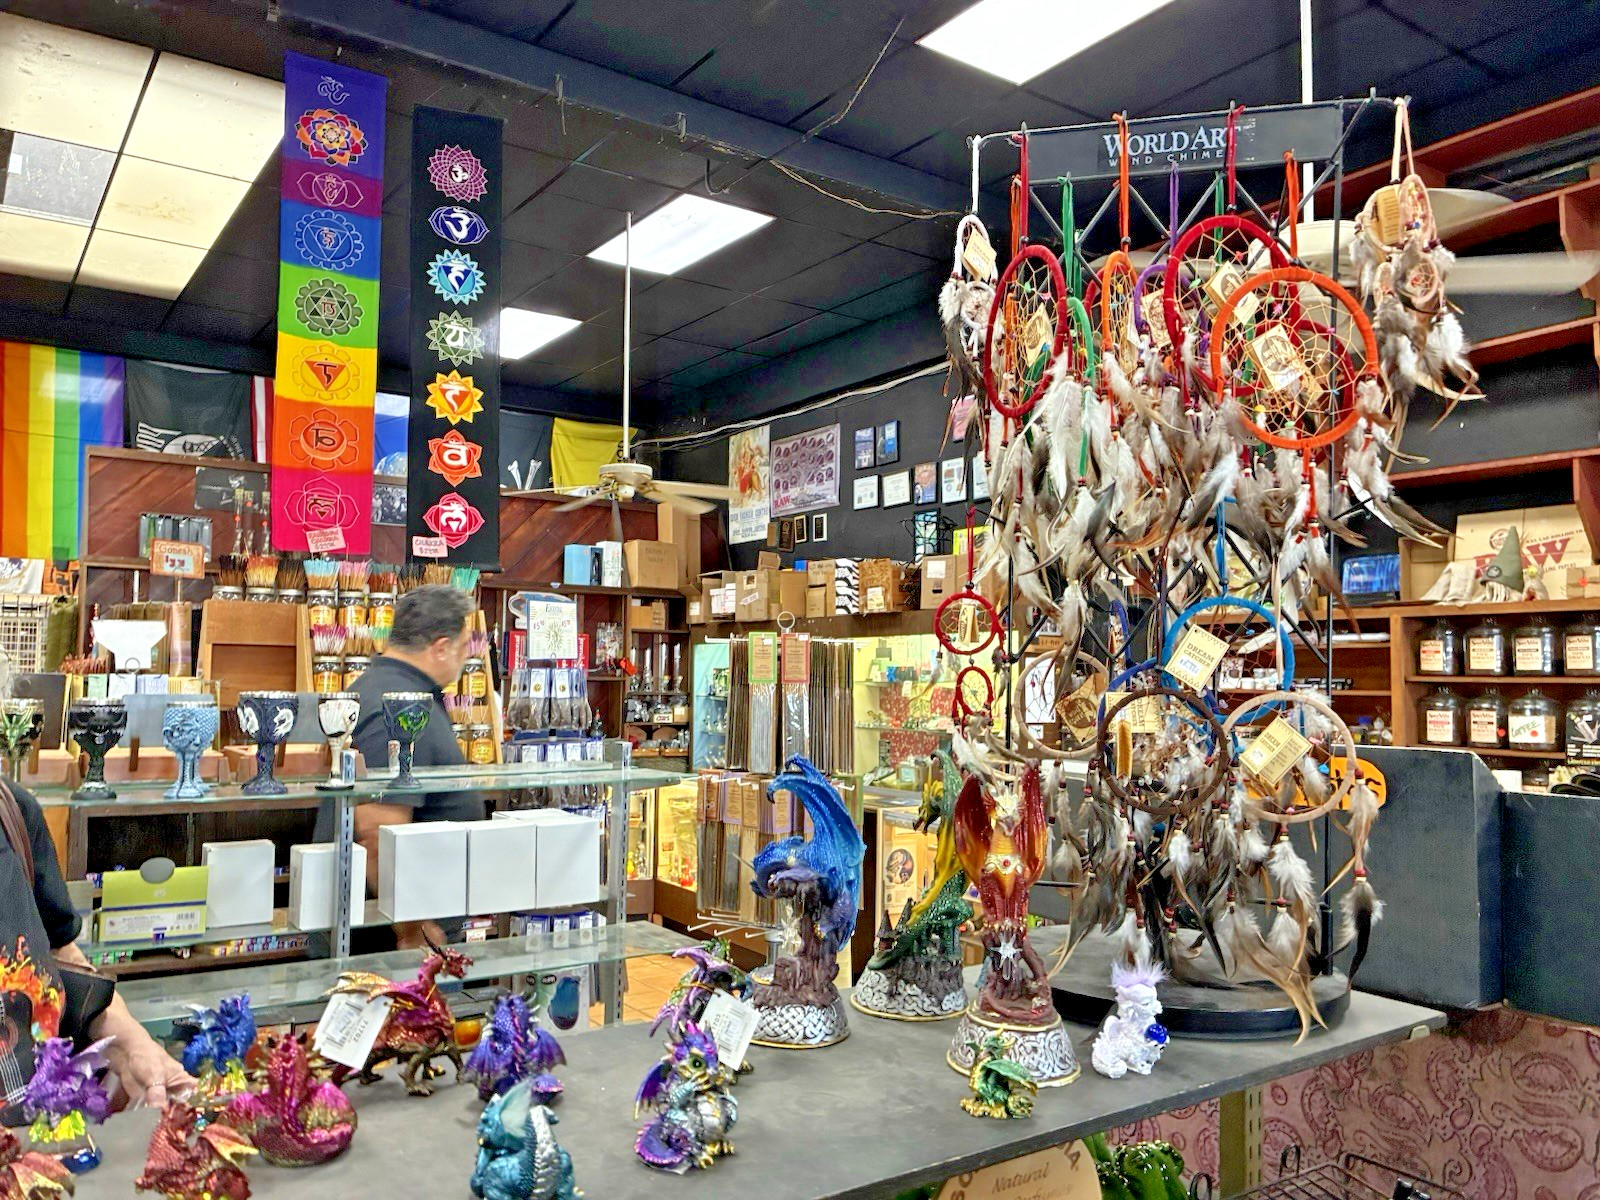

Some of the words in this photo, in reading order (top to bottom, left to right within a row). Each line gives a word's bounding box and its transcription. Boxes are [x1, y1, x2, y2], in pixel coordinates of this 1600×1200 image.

[1103, 131, 1189, 158] WORLD
[1190, 126, 1240, 151] AR
[1109, 156, 1153, 168] WND
[1167, 148, 1228, 163] CHIME
[774, 496, 791, 509] RAW
[1183, 649, 1212, 669] CATCHER
[1186, 642, 1215, 664] DREAM
[992, 1162, 1049, 1194] Natural
